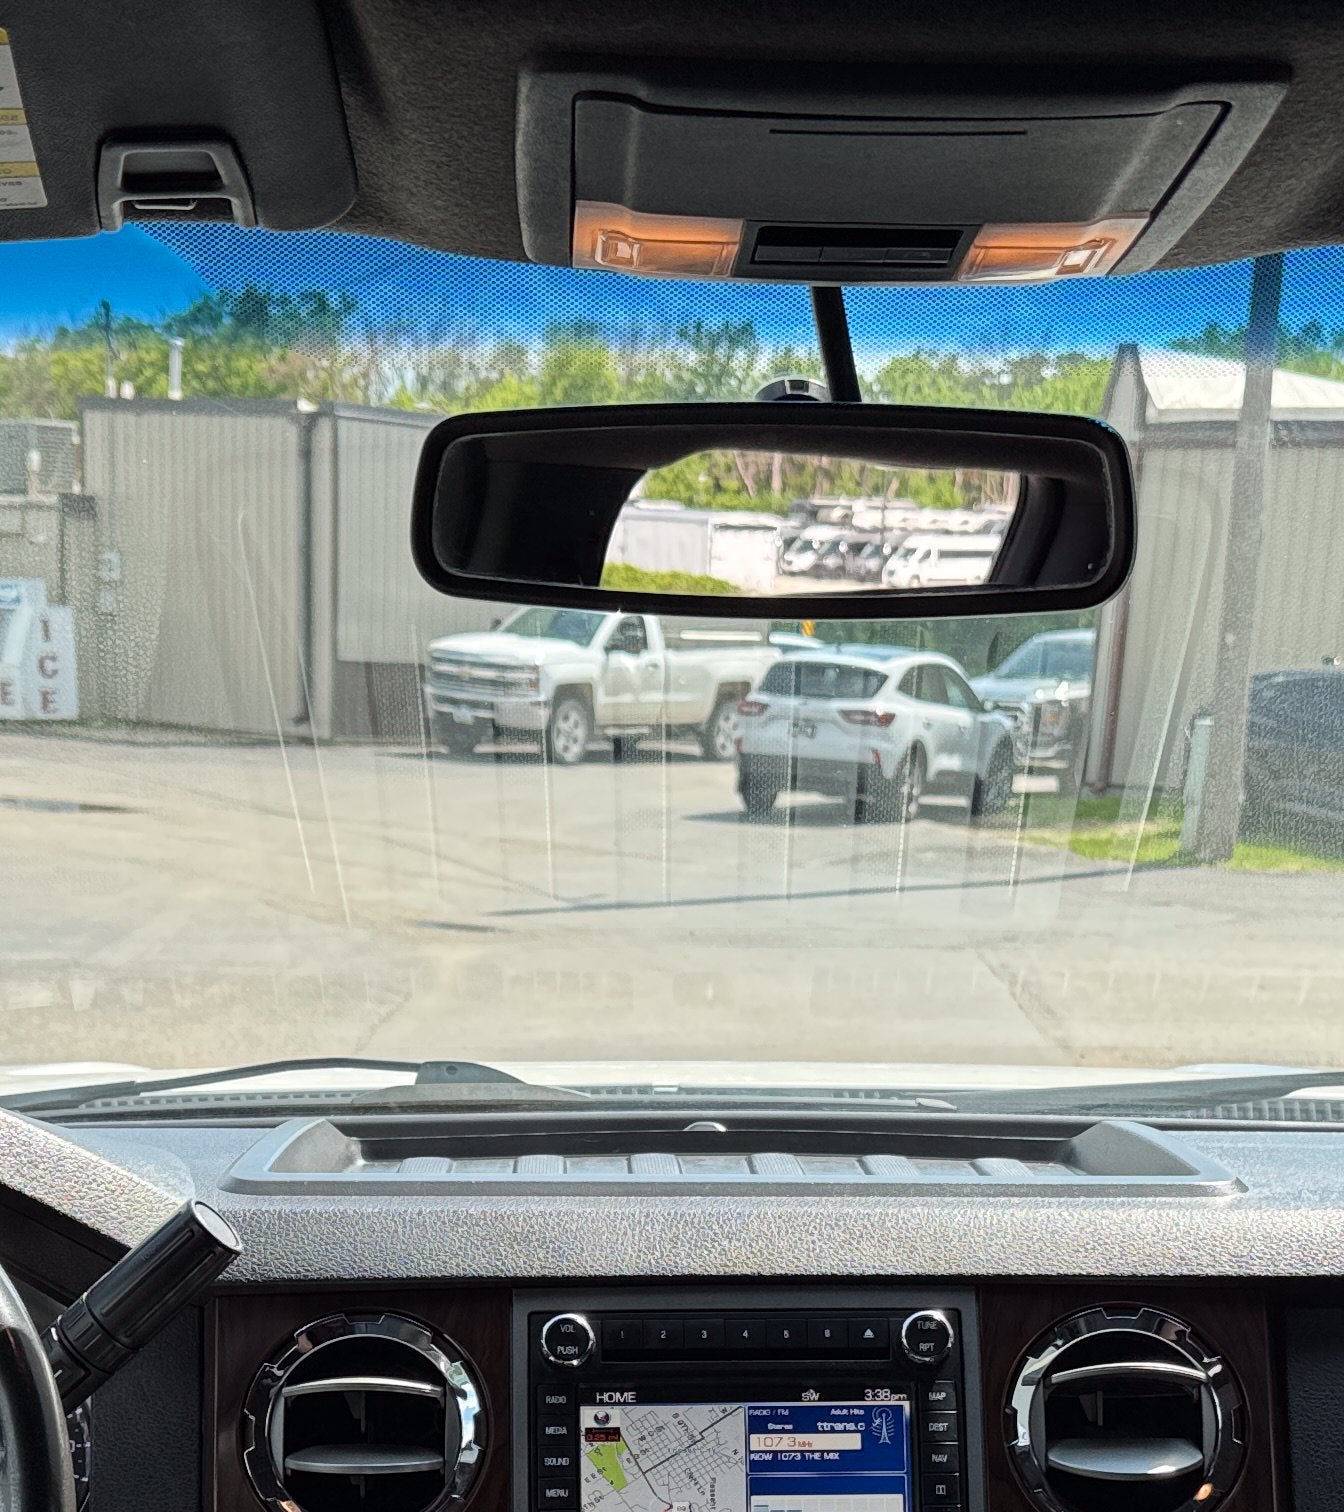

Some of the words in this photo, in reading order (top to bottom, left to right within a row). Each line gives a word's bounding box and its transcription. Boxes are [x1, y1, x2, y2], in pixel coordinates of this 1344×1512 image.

[37, 617, 61, 714] ICE
[559, 1323, 577, 1334] VOL
[916, 1319, 938, 1331] TUNE
[619, 1331, 625, 1339] 1
[659, 1331, 667, 1339] 2
[700, 1330, 709, 1339] 3
[741, 1330, 750, 1339] 4
[782, 1330, 791, 1339] 5
[557, 1344, 579, 1355] PUSH
[918, 1341, 935, 1353] RPT
[545, 1394, 568, 1405] RADIO
[594, 1391, 638, 1403] HOME
[801, 1391, 820, 1402] SW
[928, 1391, 947, 1401] MAP
[545, 1425, 569, 1436] MEDIA
[928, 1422, 950, 1432] DEST
[543, 1456, 571, 1467] SOUND
[777, 1452, 802, 1461] 1073
[931, 1453, 949, 1464] NAV
[544, 1488, 570, 1499] MENU
